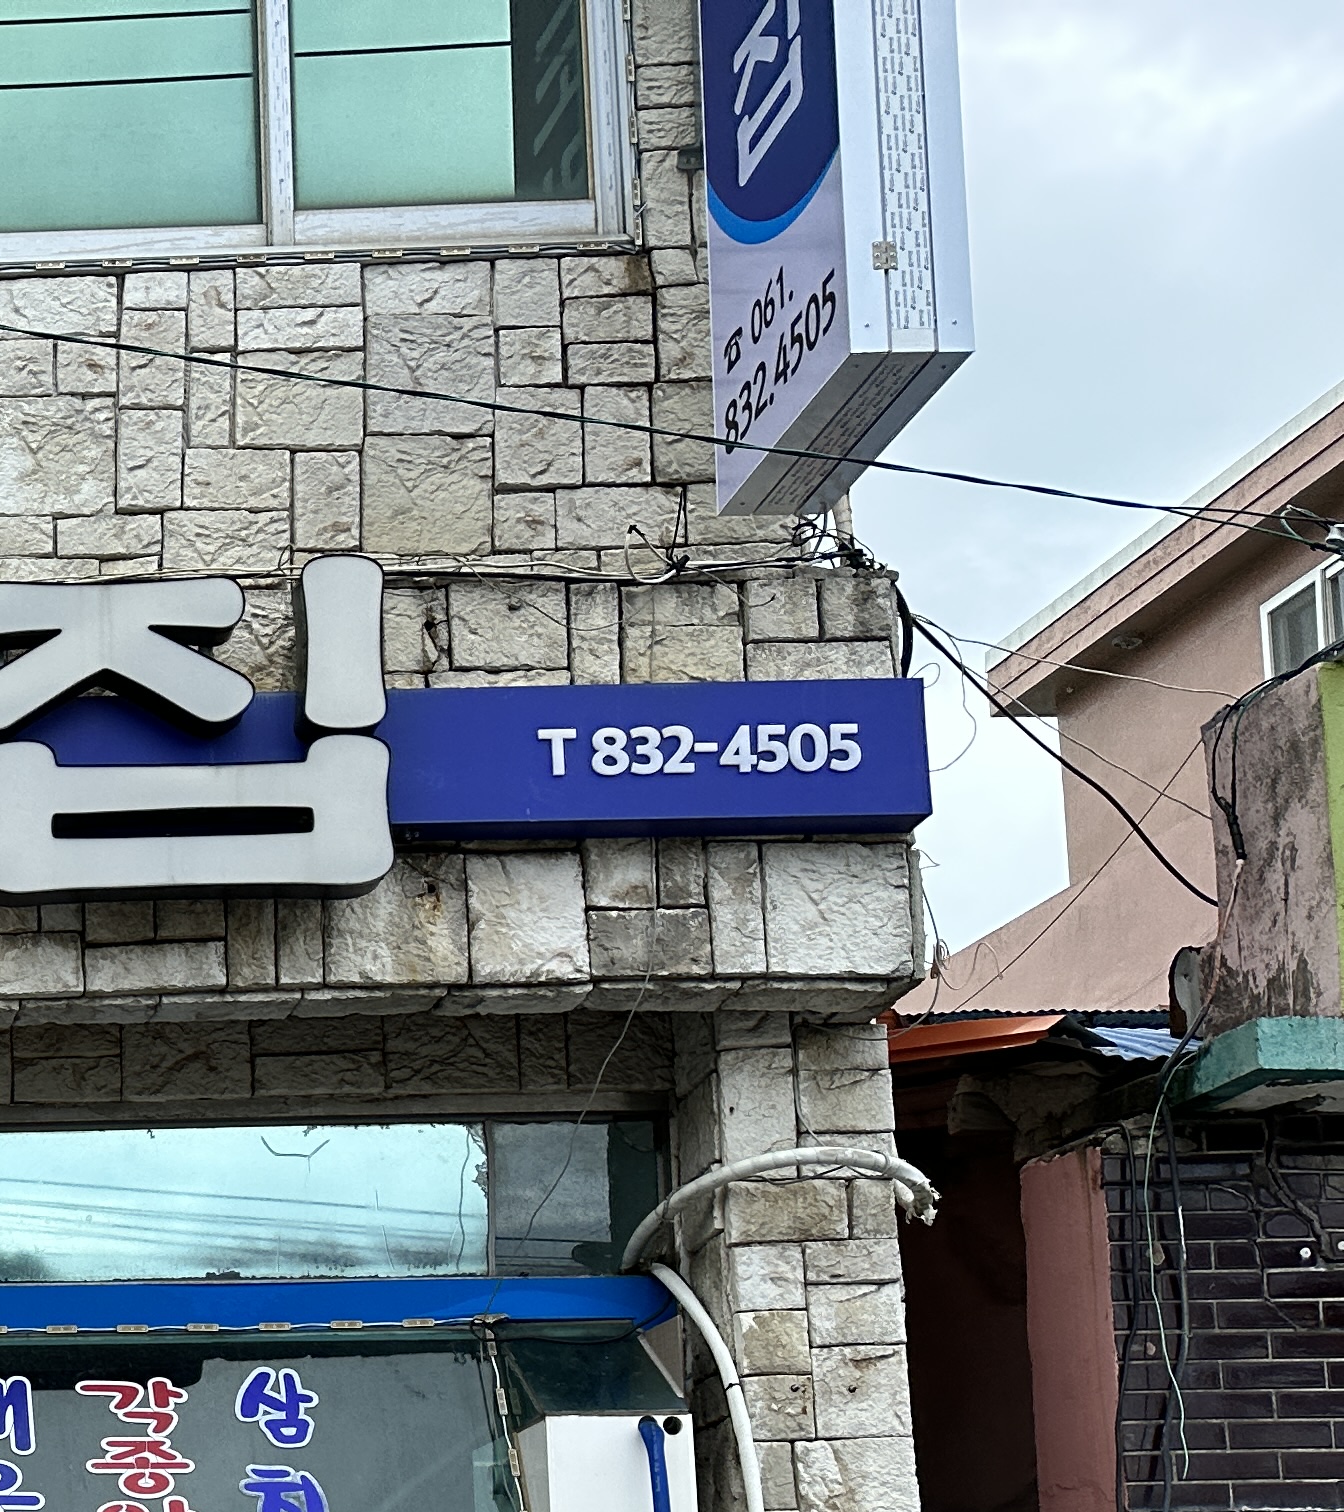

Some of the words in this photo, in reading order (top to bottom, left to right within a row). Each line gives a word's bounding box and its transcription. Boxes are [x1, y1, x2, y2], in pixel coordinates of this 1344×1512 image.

[750, 266, 794, 345] 061.
[725, 268, 837, 455] 832.4505
[537, 728, 577, 776] T
[591, 723, 863, 776] 832-4505
